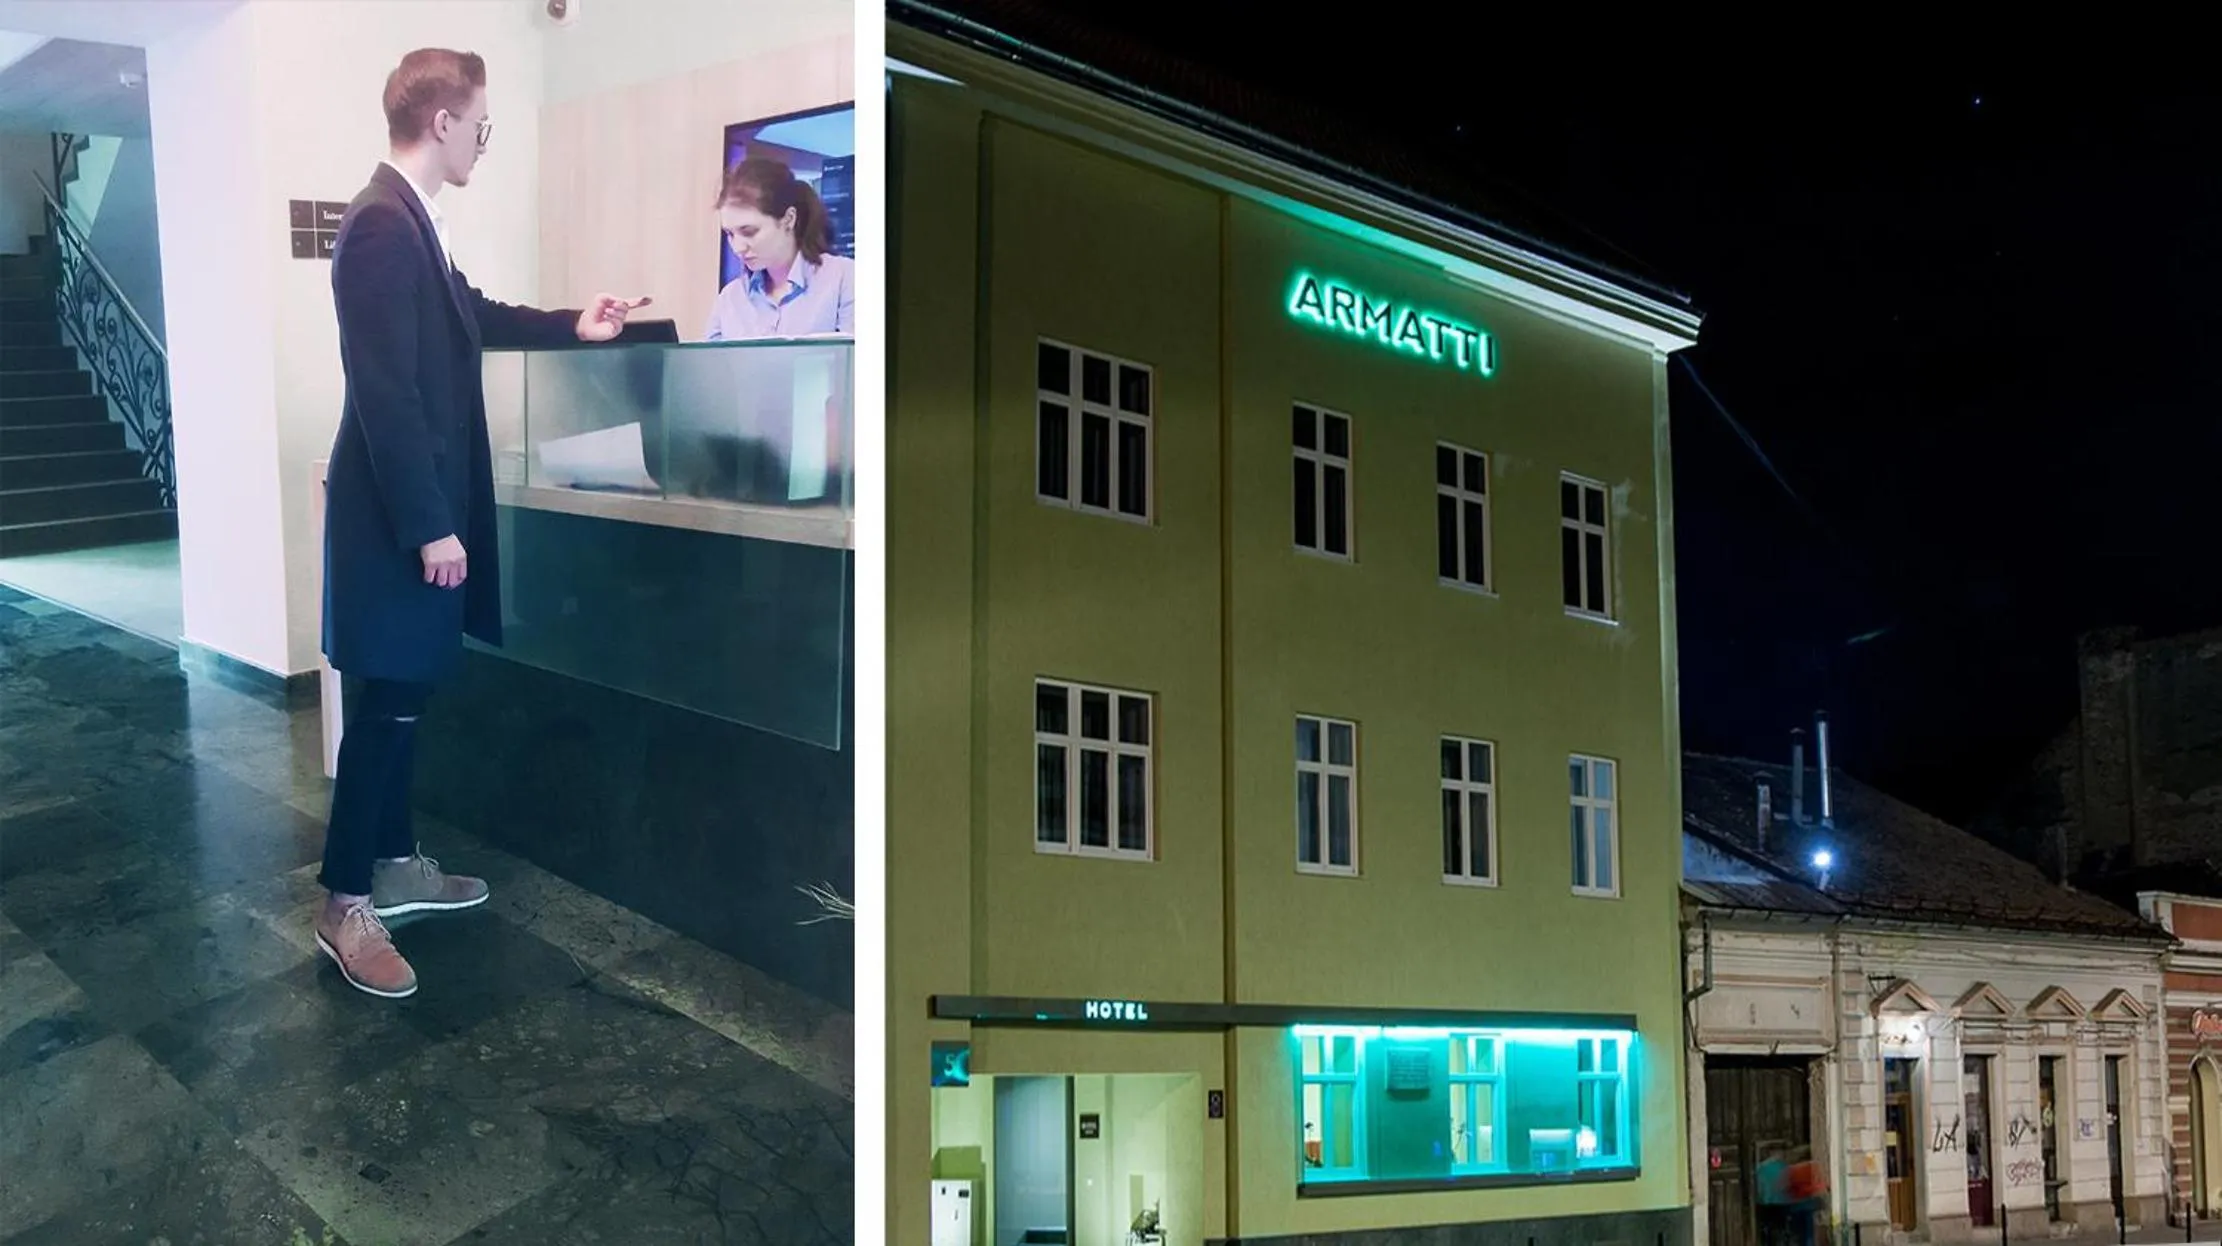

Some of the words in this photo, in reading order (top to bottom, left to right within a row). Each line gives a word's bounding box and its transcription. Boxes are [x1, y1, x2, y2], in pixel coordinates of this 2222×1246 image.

[323, 210, 344, 221] Inter
[1290, 273, 1495, 375] ARMATTI
[1086, 1001, 1148, 1020] HOTEL
